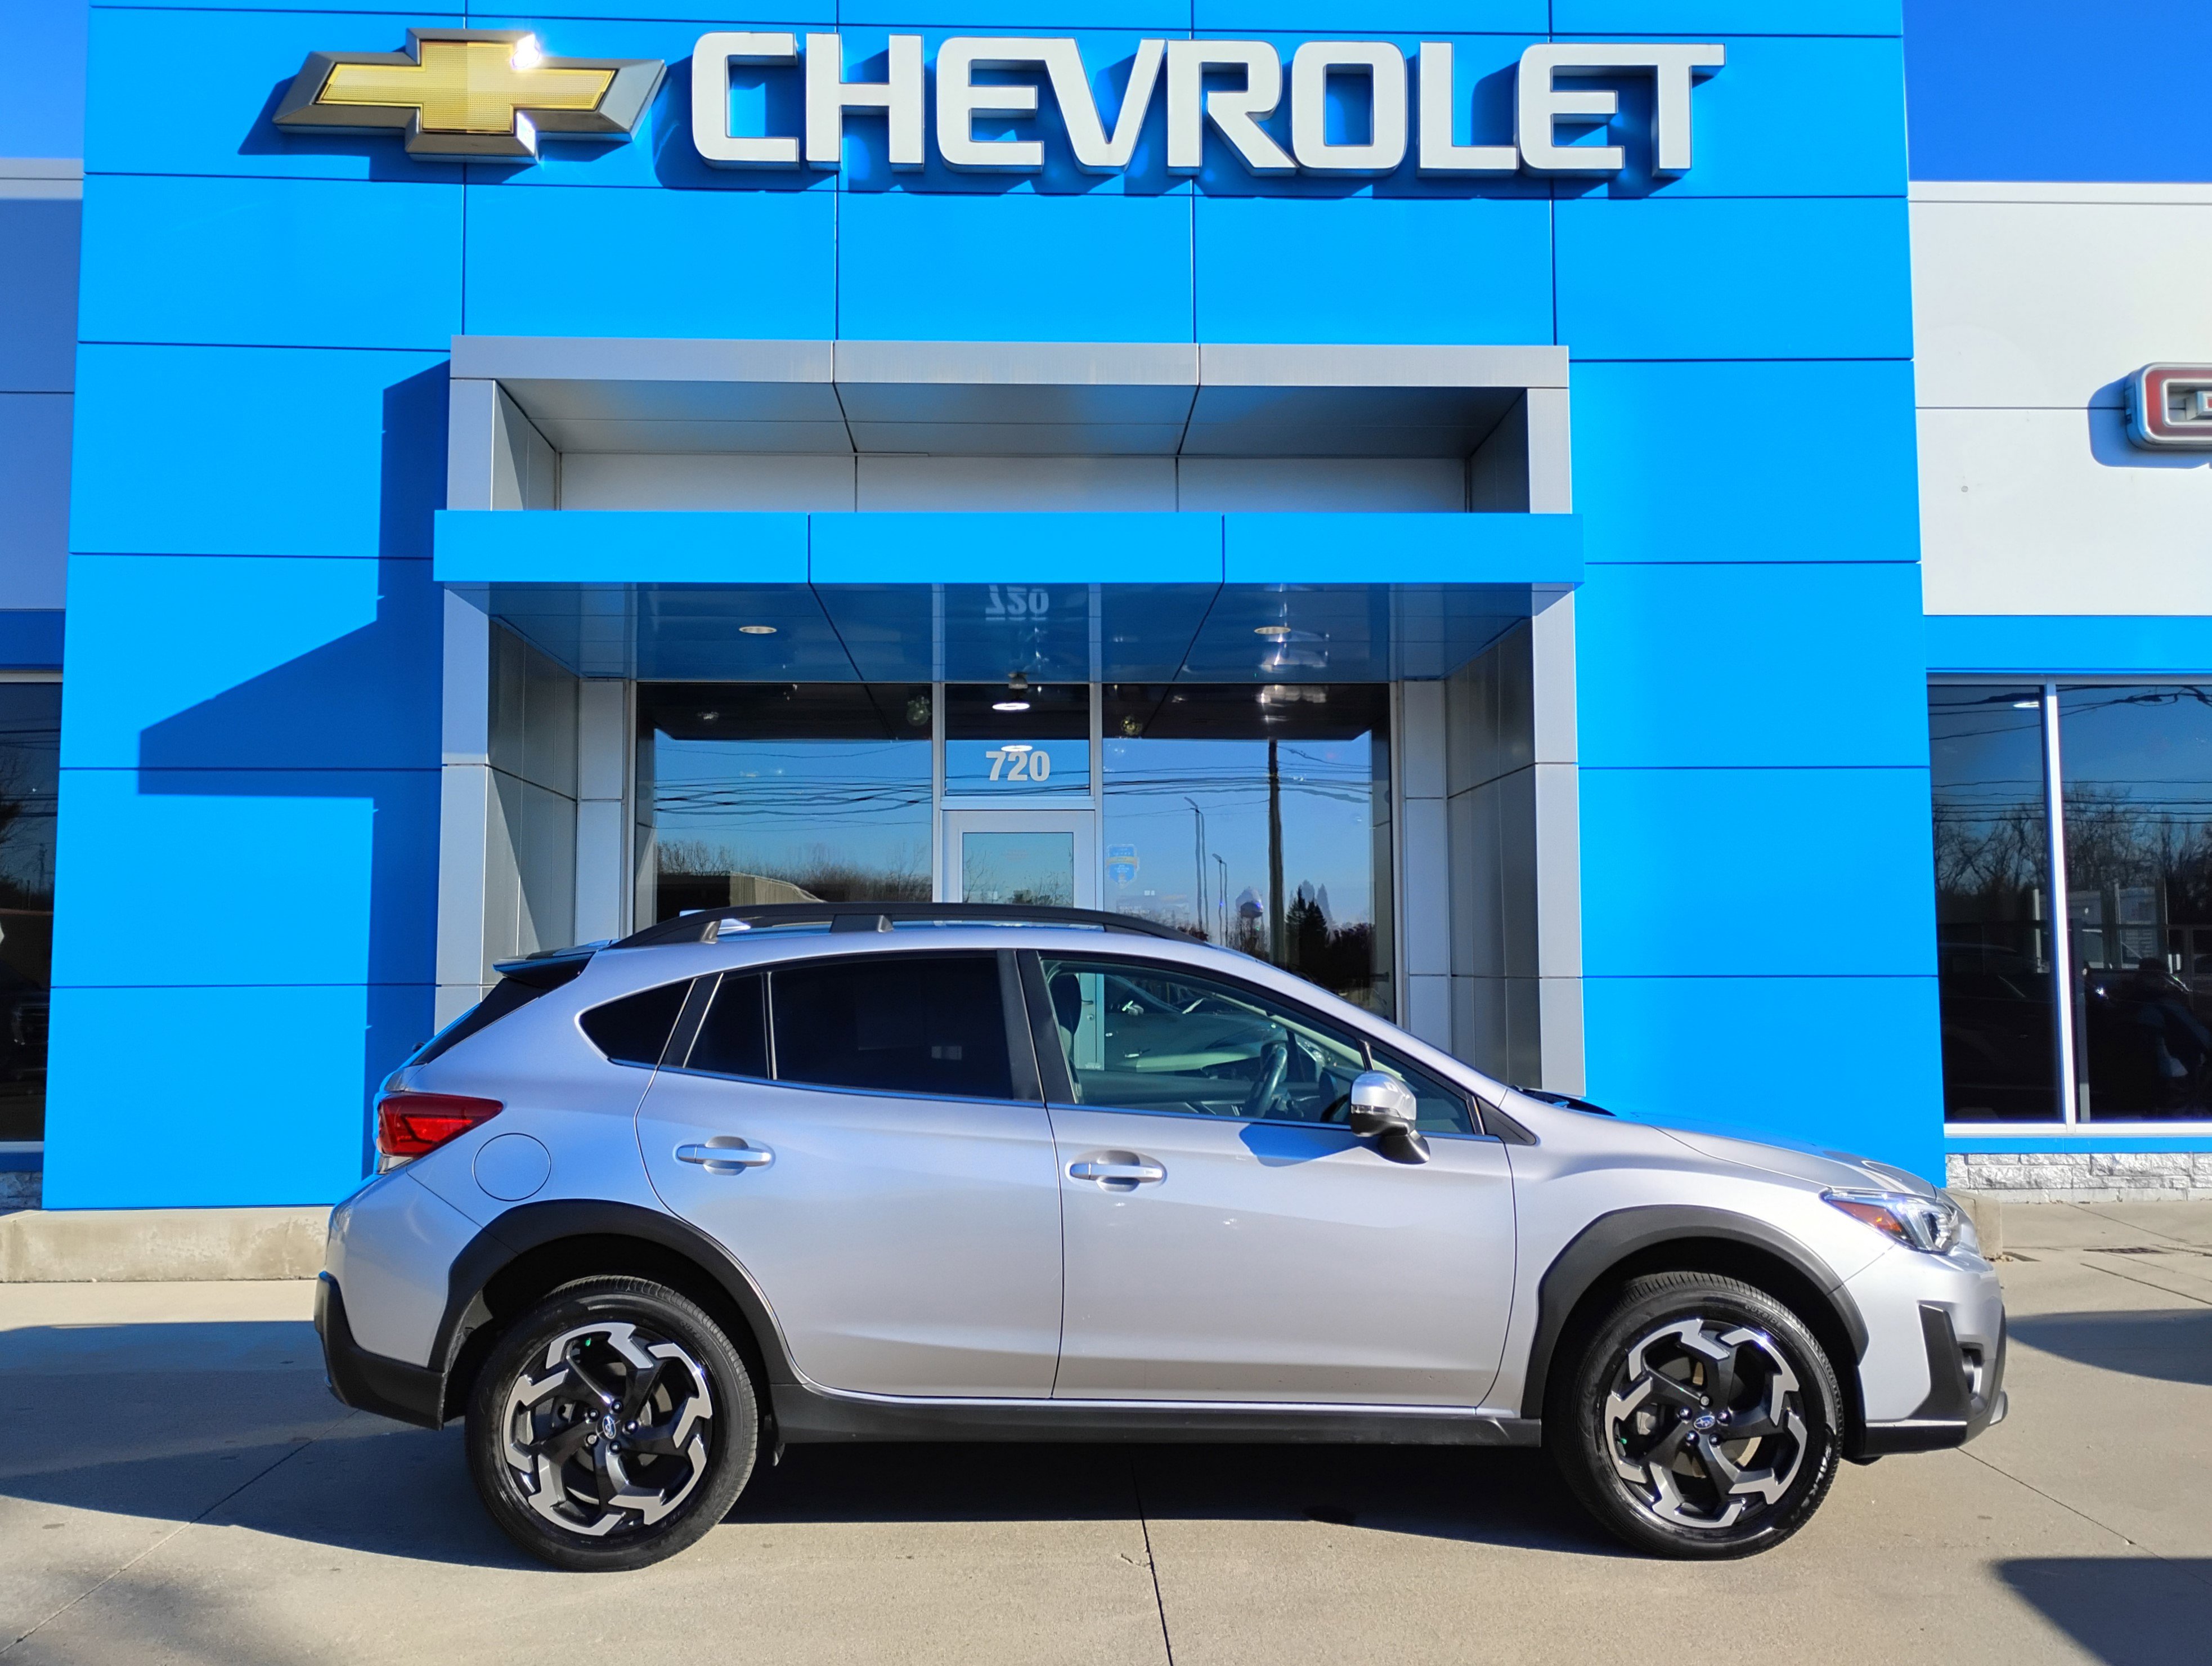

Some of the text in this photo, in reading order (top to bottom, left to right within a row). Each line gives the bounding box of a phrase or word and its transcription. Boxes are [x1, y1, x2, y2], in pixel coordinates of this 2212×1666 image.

[691, 32, 1725, 177] CHEVROLET
[986, 751, 1051, 782] 720
[1744, 1305, 1782, 1328] OUTSIDE
